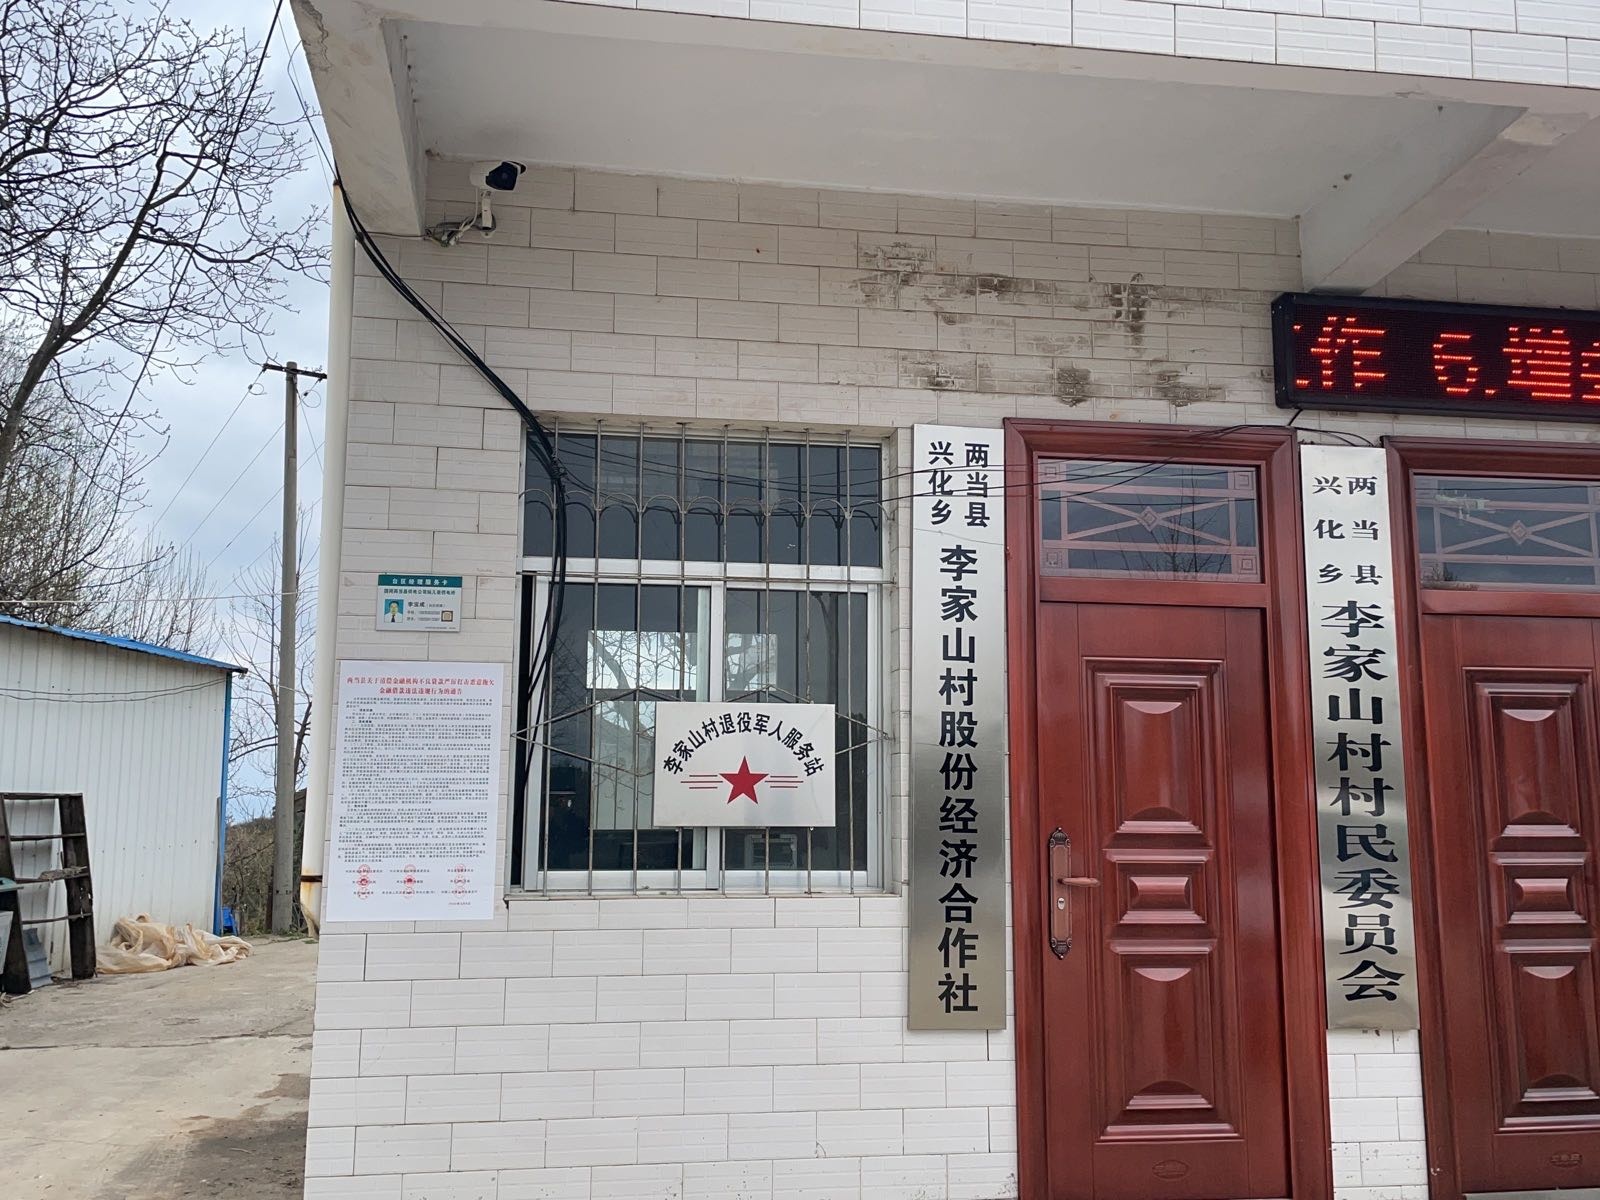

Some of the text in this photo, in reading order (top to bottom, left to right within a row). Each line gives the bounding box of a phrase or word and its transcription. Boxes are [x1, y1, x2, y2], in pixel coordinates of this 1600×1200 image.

[1433, 326, 1600, 400] 6.增
[928, 441, 954, 525] 兴化乡
[964, 441, 990, 528] 两当县
[1312, 475, 1345, 584] 兴化乡
[1346, 475, 1383, 586] 两当县
[663, 711, 825, 777] 李家山村退役军人服务站
[937, 544, 979, 1014] 李家山村股份经济合作社
[1320, 600, 1405, 1001] 李家山村村民委员会
